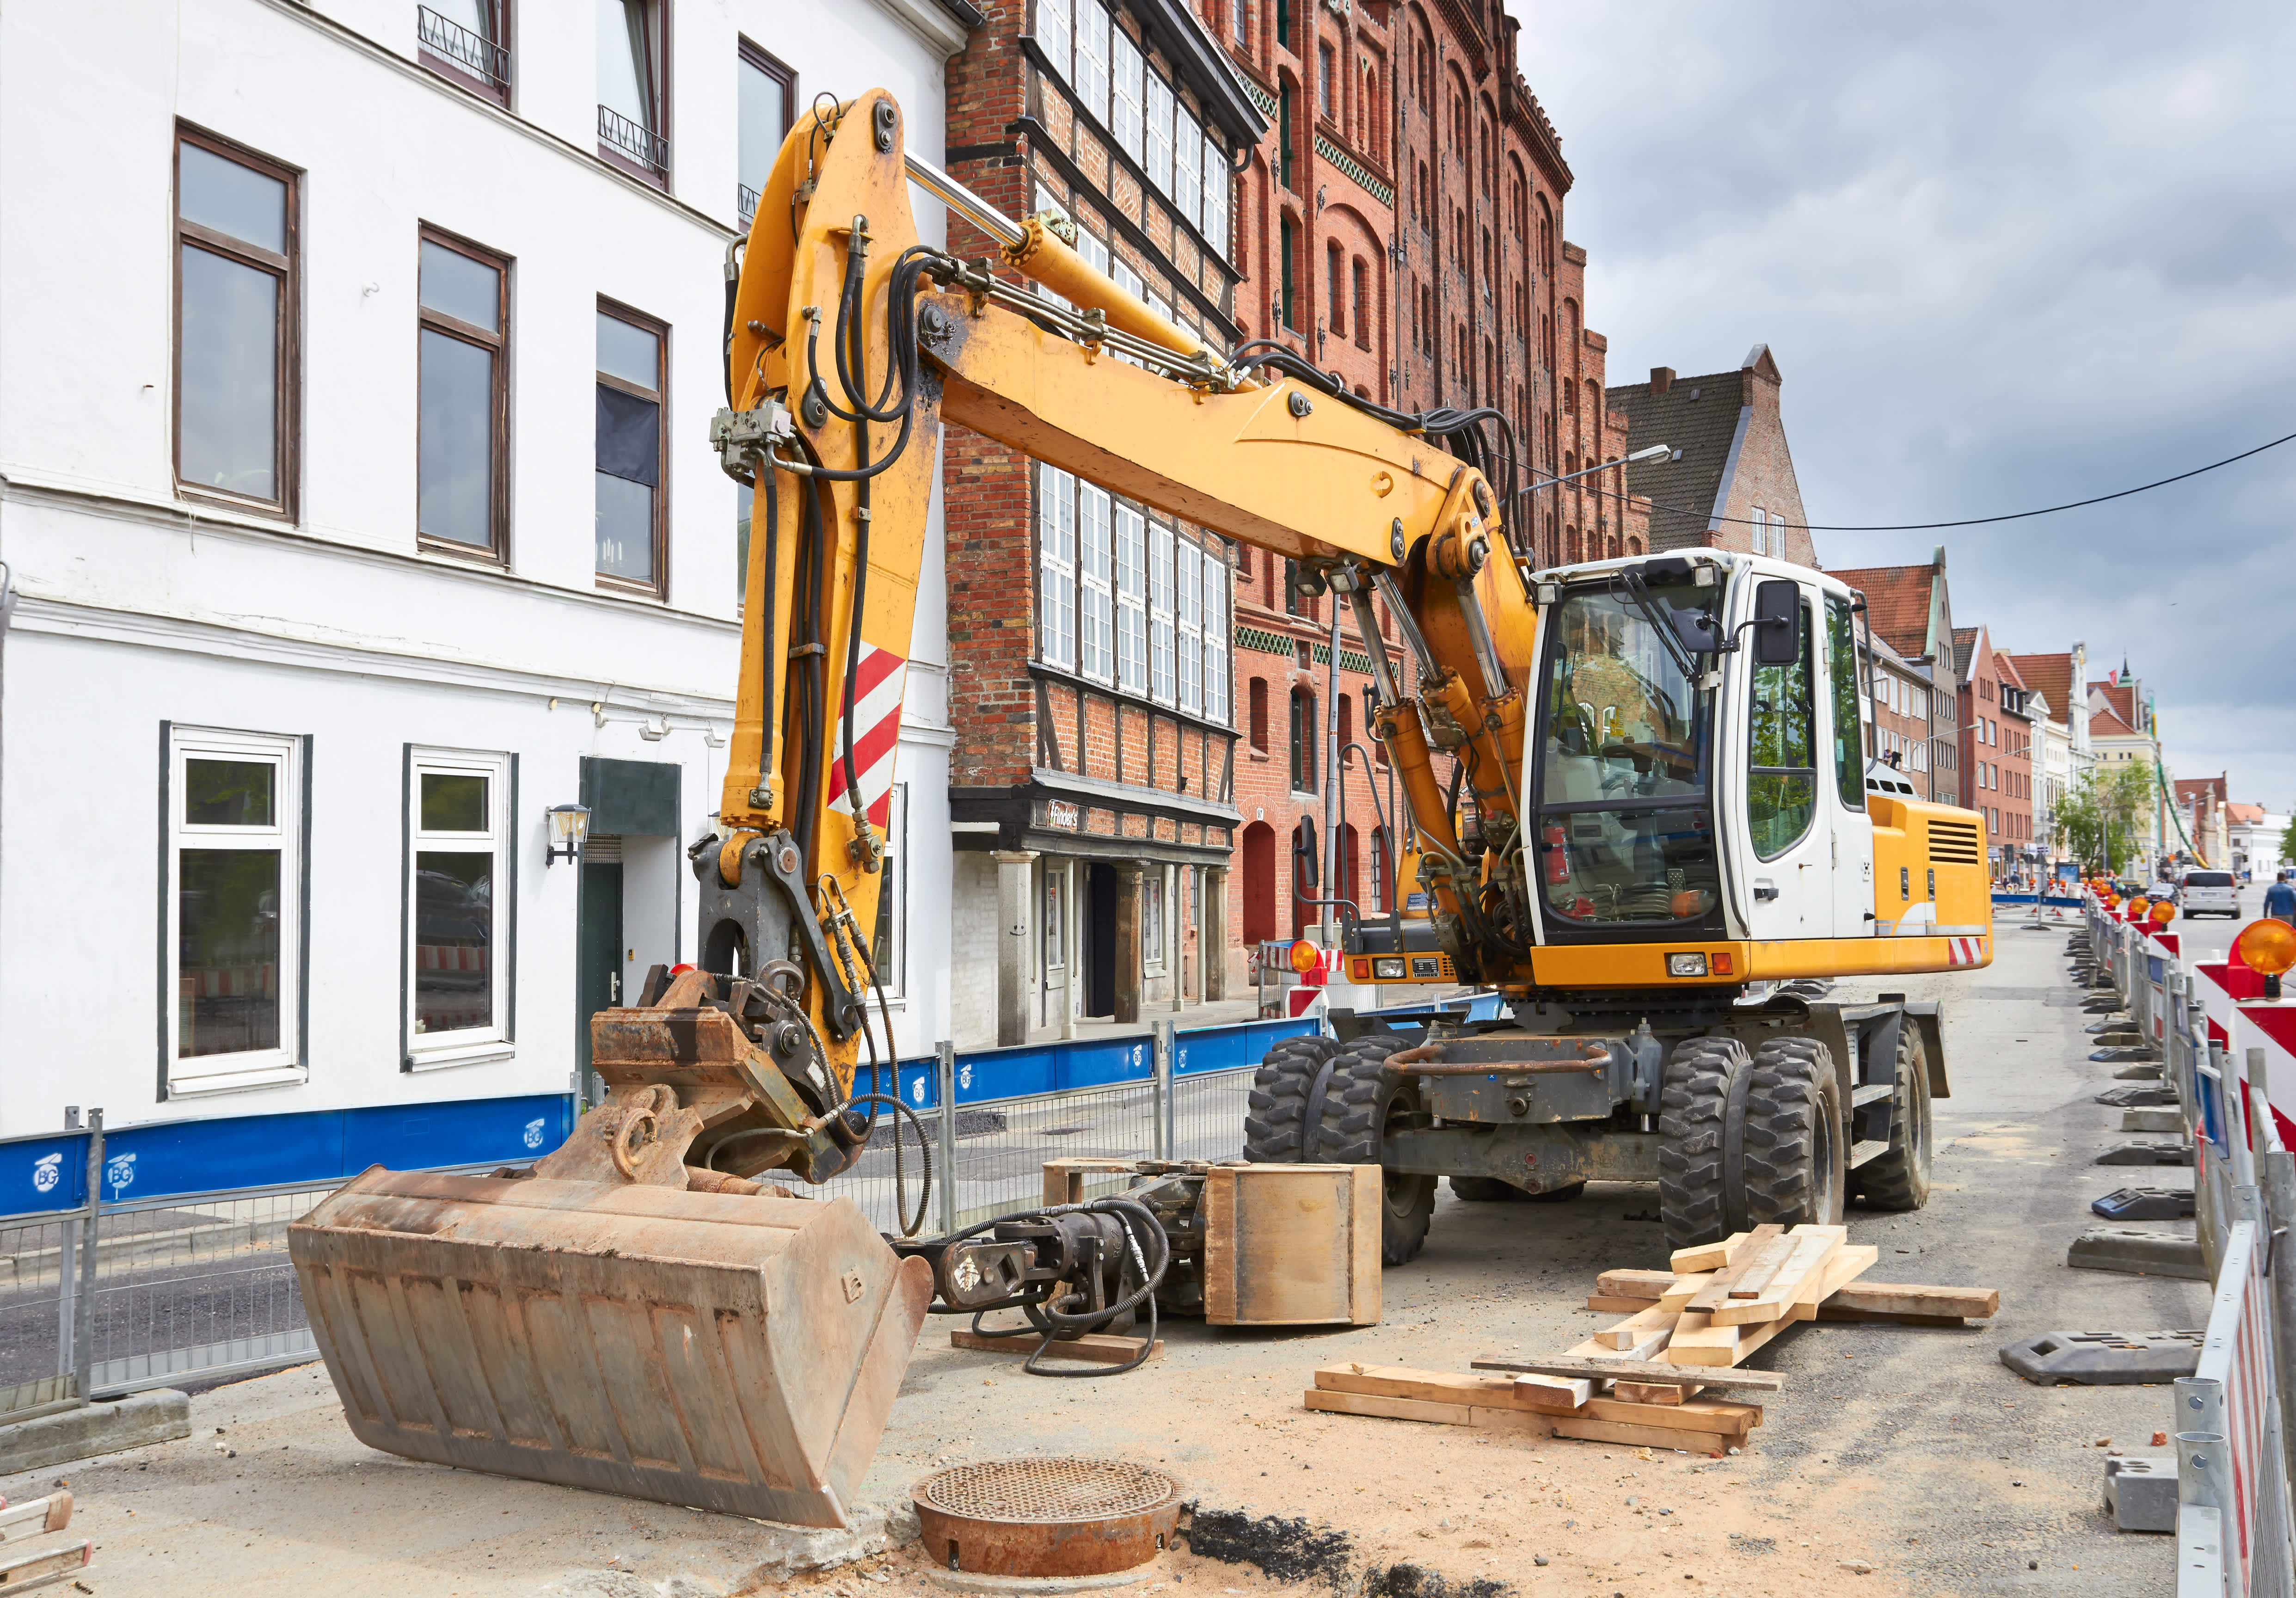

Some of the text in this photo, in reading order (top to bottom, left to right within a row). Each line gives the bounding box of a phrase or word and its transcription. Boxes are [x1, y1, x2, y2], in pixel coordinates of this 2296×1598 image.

[1053, 805, 1078, 827] Finder's
[915, 1088, 923, 1098] BG
[38, 1169, 58, 1185] BG
[112, 1167, 131, 1183] BG
